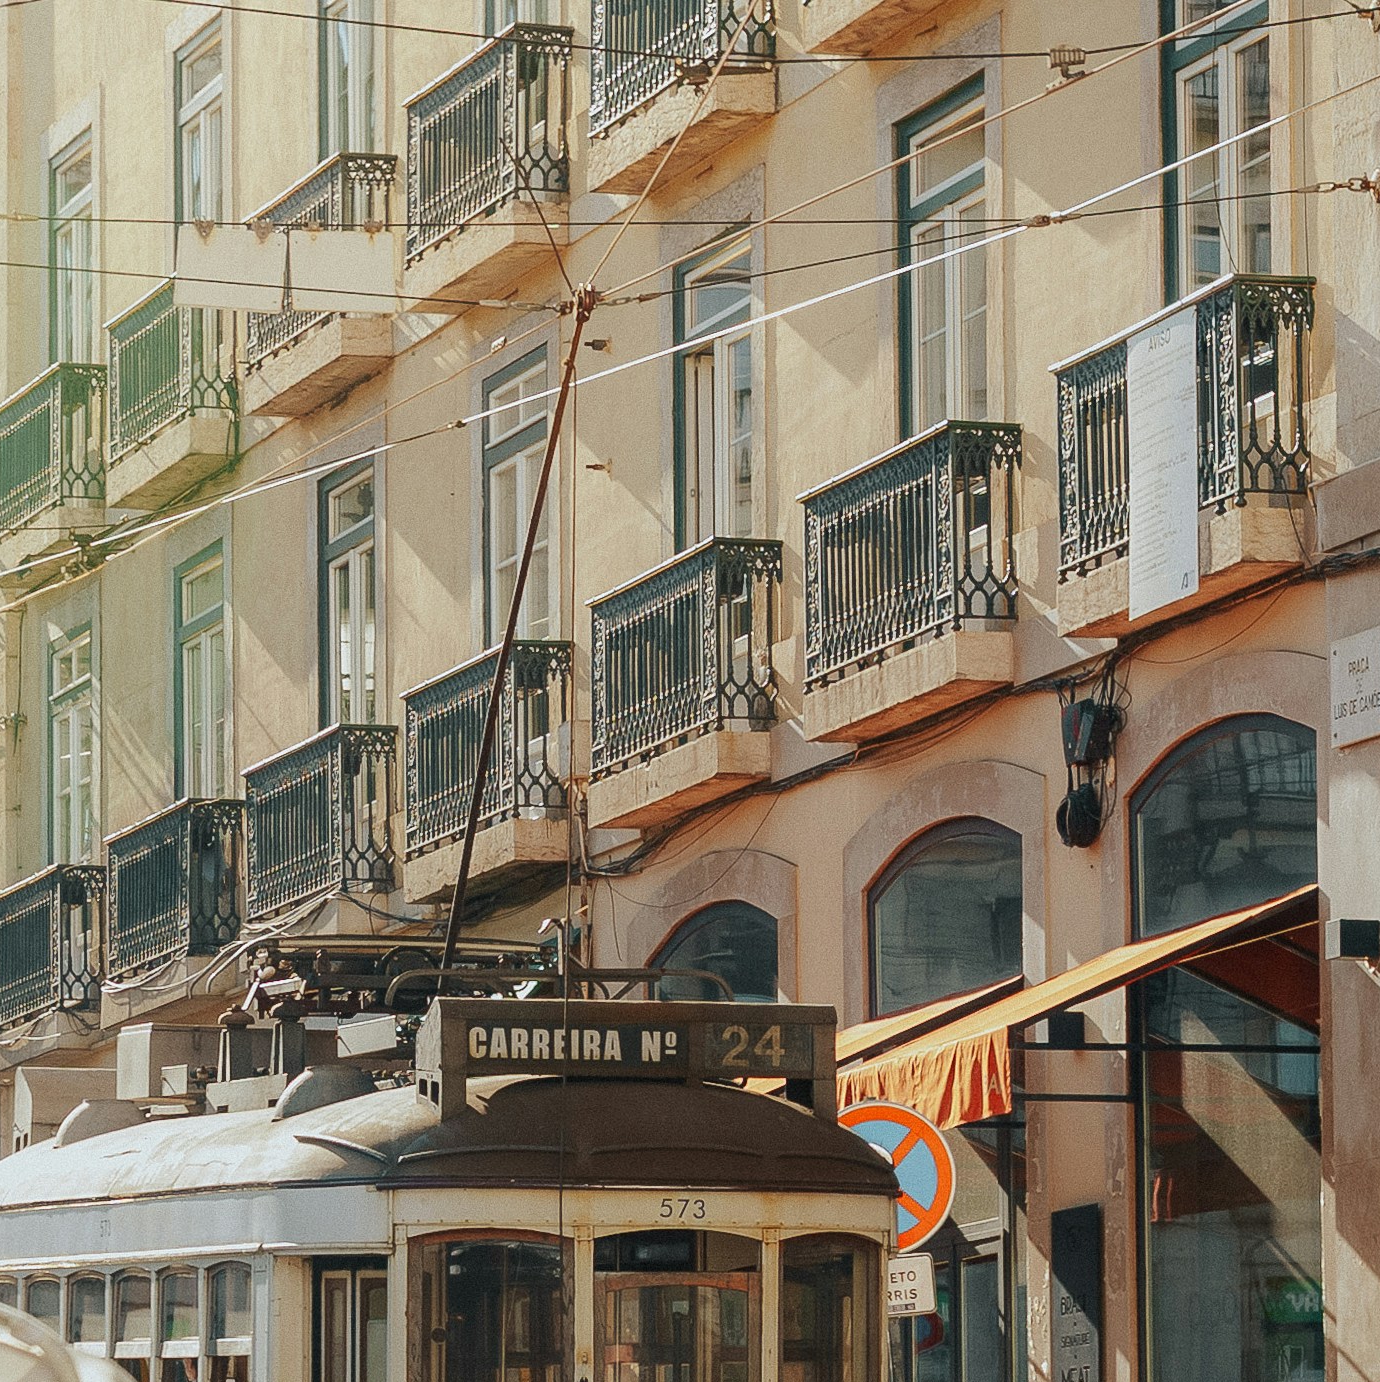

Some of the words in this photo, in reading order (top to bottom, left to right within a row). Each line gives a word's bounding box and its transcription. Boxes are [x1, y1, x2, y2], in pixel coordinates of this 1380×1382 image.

[1148, 328, 1171, 353] AVISO
[468, 1026, 623, 1062] CARREIRA
[721, 1024, 787, 1068] 24
[660, 1198, 706, 1219] 573
